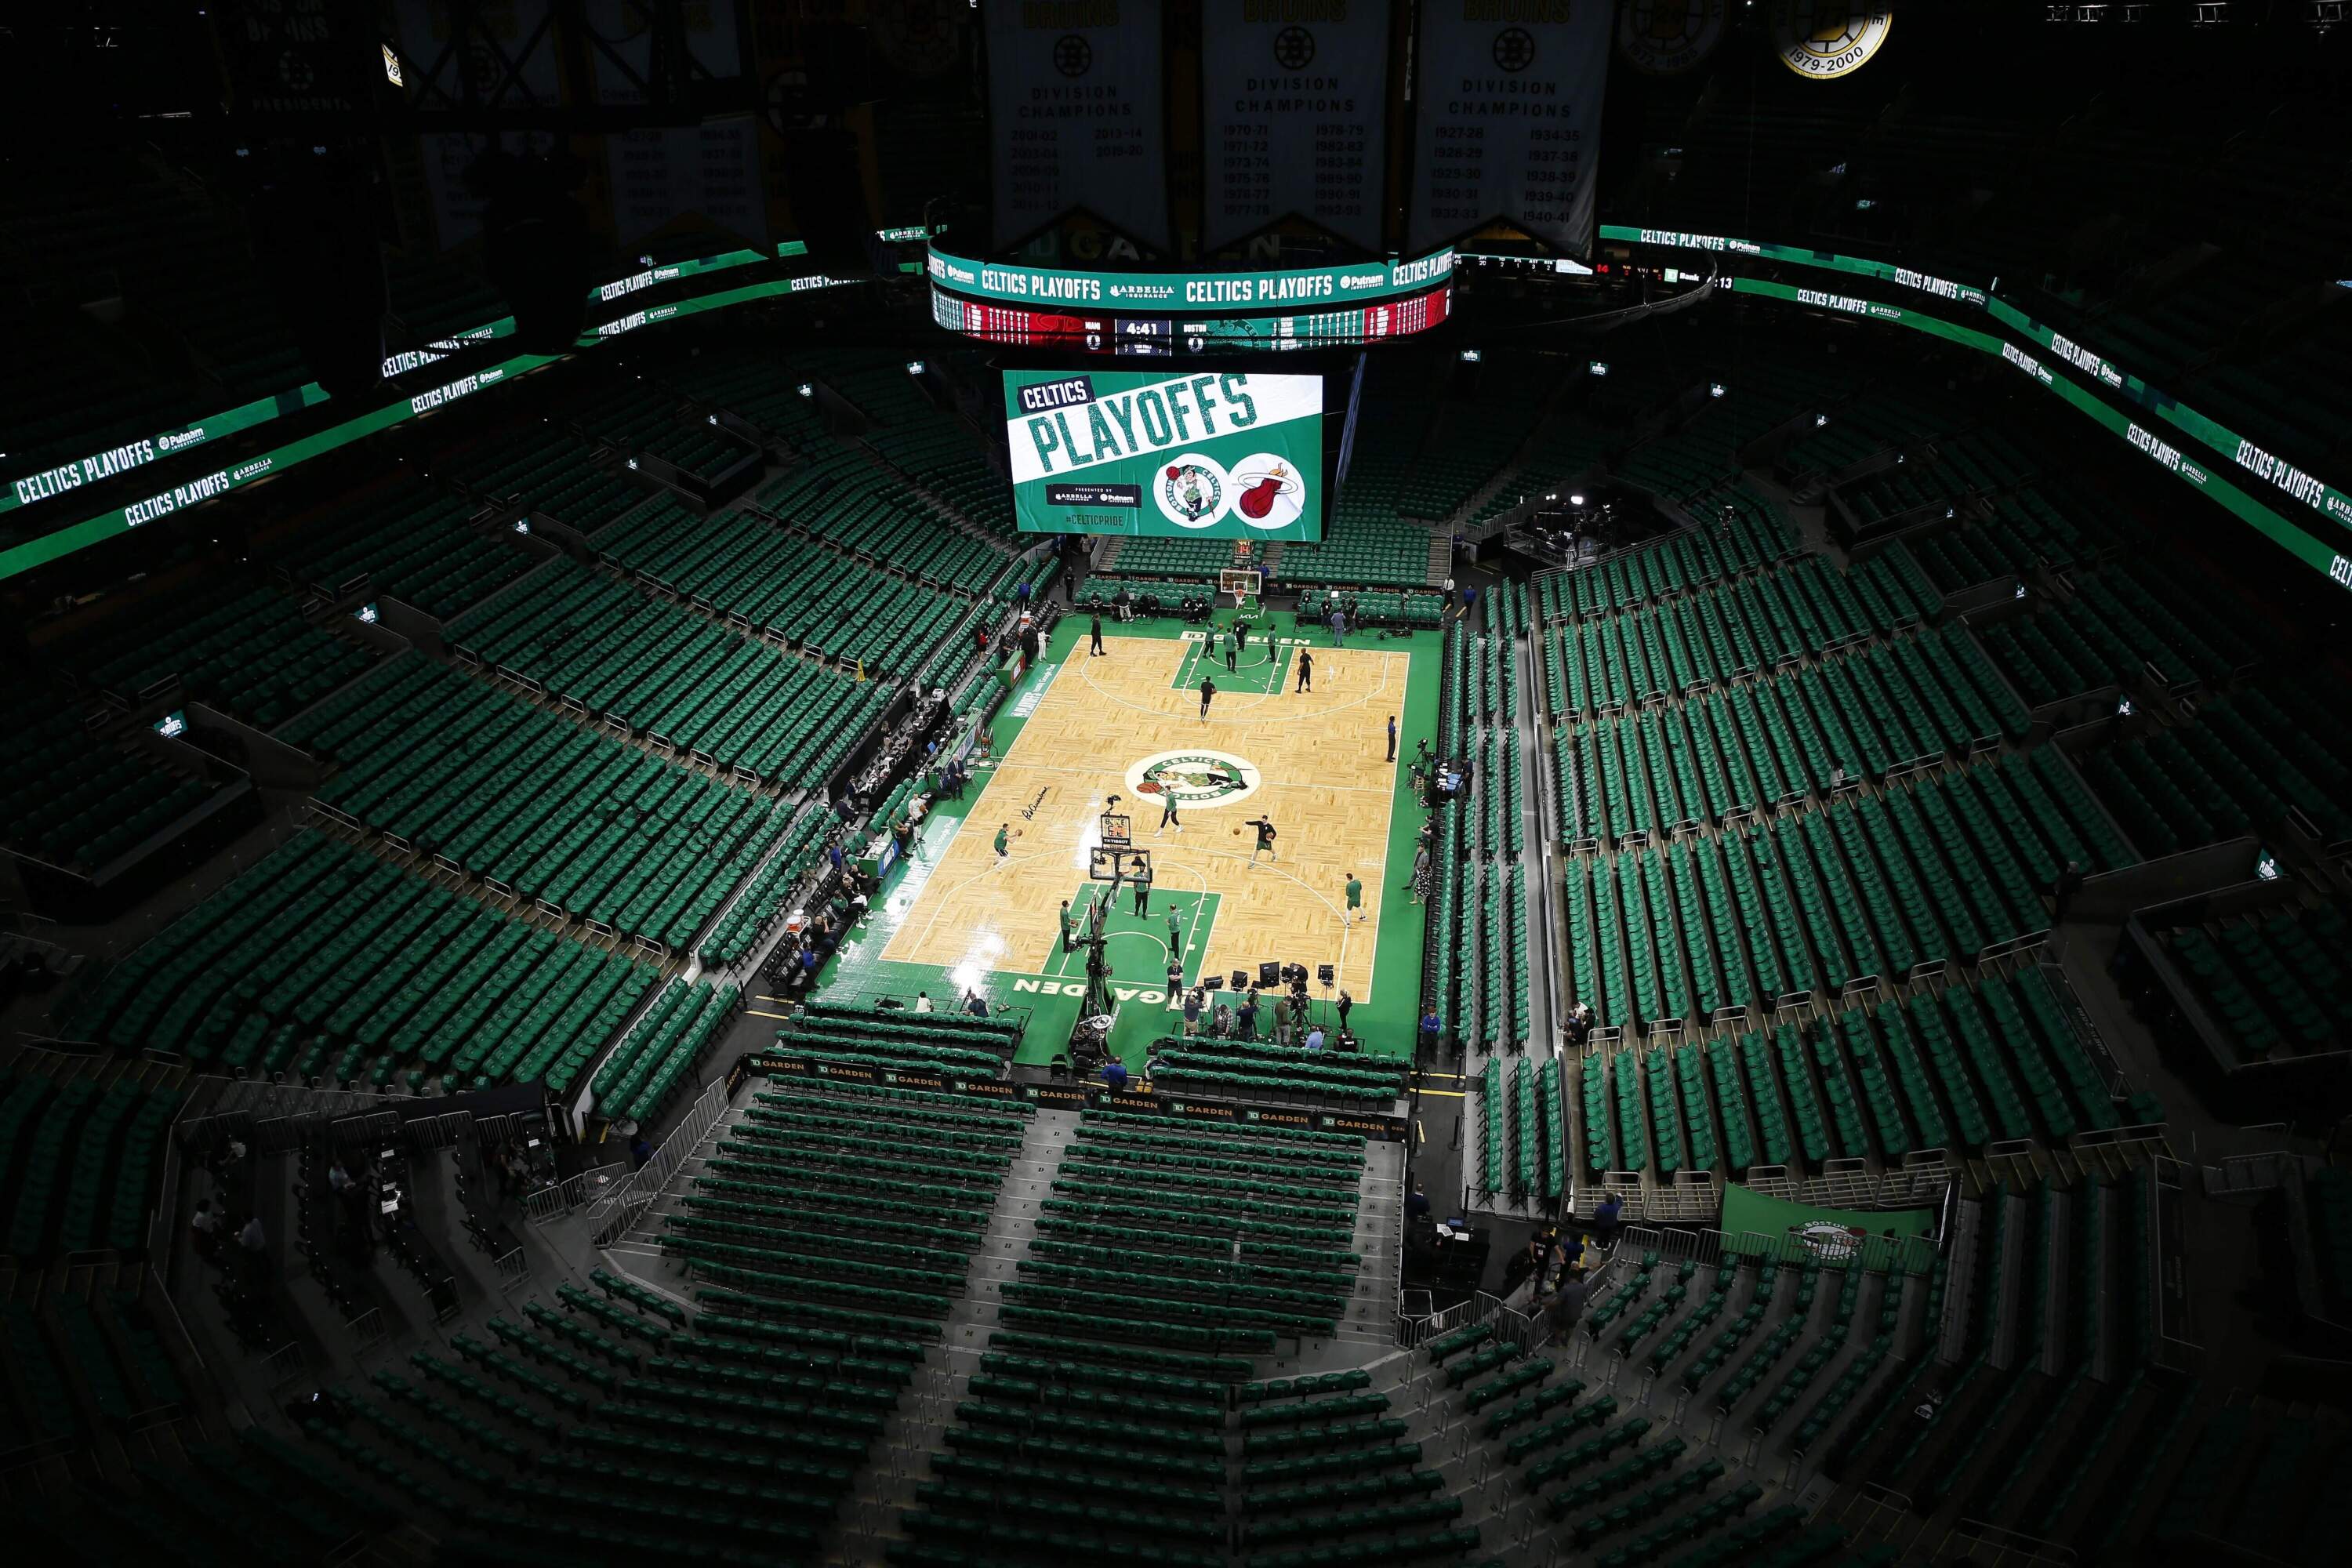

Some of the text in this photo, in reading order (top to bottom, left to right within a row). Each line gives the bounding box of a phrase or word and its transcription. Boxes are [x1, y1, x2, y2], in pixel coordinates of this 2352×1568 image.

[1789, 45, 1863, 71] 1979-2000
[1247, 78, 1338, 91] DIVISION
[1462, 80, 1556, 95] DIVISION
[1032, 85, 1117, 100] DIVISION
[1018, 103, 1132, 119] CHAMPIONS
[1236, 100, 1355, 112] CHAMPIONS
[1449, 101, 1571, 118] CHAMPIONS
[1094, 128, 1142, 140] 2013-14
[1224, 125, 1268, 135] 1970-71
[1316, 125, 1363, 135] 1978-79
[1436, 127, 1484, 139] 1927-28
[1530, 129, 1580, 141] 1934-35
[1224, 141, 1268, 151] 1971-72
[1224, 158, 1269, 168] 1973-74
[1527, 171, 1576, 182] 1938-39
[1525, 191, 1574, 201] 1939-40
[1523, 211, 1570, 223] 1940-41
[1641, 229, 1725, 251] CELTICS PLAYOFFS
[1737, 241, 1760, 252] Putnam
[1350, 274, 1384, 287] Putnam
[1392, 260, 1428, 286] CELTICS
[1679, 272, 1700, 281] Bank
[601, 270, 653, 301] CELTICS PLAYOFFS
[791, 276, 822, 292] CELTICS
[982, 269, 1101, 300] CELTICS PLAYOFFS
[1120, 285, 1174, 294] ARBELLA
[1185, 275, 1332, 303] CELTICS PLAYOFFS
[1894, 267, 1958, 299] CELTICS PLAYOFFS
[1797, 289, 1867, 314] CELTICS PLAYOFFS
[620, 311, 646, 332] PLAYOFFS
[1126, 323, 1157, 335] 4:41
[1183, 324, 1207, 333] BOSTON
[1087, 332, 1101, 350] 0
[1188, 334, 1204, 352] 0
[2002, 342, 2038, 376] CELTICS PLAYOFFS
[2051, 332, 2100, 377] CELTICS PLAYOFFS
[382, 350, 418, 378] CELTICS
[412, 376, 477, 413] CELTICS PLAYOFFS
[1023, 380, 1087, 410] CELTICS
[1027, 373, 1258, 473] PLAYOFFS
[169, 427, 204, 445] Putnam
[2127, 423, 2180, 470] CELTICS PLAYOFFS
[16, 439, 154, 504] CELTICS PLAYOFFS
[239, 458, 272, 474] ARBELLA
[2186, 465, 2207, 482] ARBELLA
[2235, 439, 2325, 509] CELTICS PLAYOFFS
[1202, 470, 1221, 501] CELTICS
[125, 471, 230, 526] CELTICS PLAYOFFS
[1166, 479, 1183, 512] BOSTON
[1066, 514, 1123, 527] #CELTICPRIDE
[1163, 757, 1221, 767] CELTICS
[1013, 978, 1167, 1004] GADEN
[763, 1061, 804, 1070] GARDEN
[830, 1068, 872, 1078] GARDEN
[898, 1076, 941, 1087] GARDEN
[968, 1084, 1013, 1094] GARDEN
[1040, 1091, 1085, 1100] GARDEN
[1113, 1098, 1158, 1109] GARDEN
[1186, 1106, 1232, 1116] GARDEN
[1261, 1113, 1308, 1123] GARDEN
[1337, 1120, 1385, 1131] GARDEN
[1804, 1221, 1849, 1230] BOSTON
